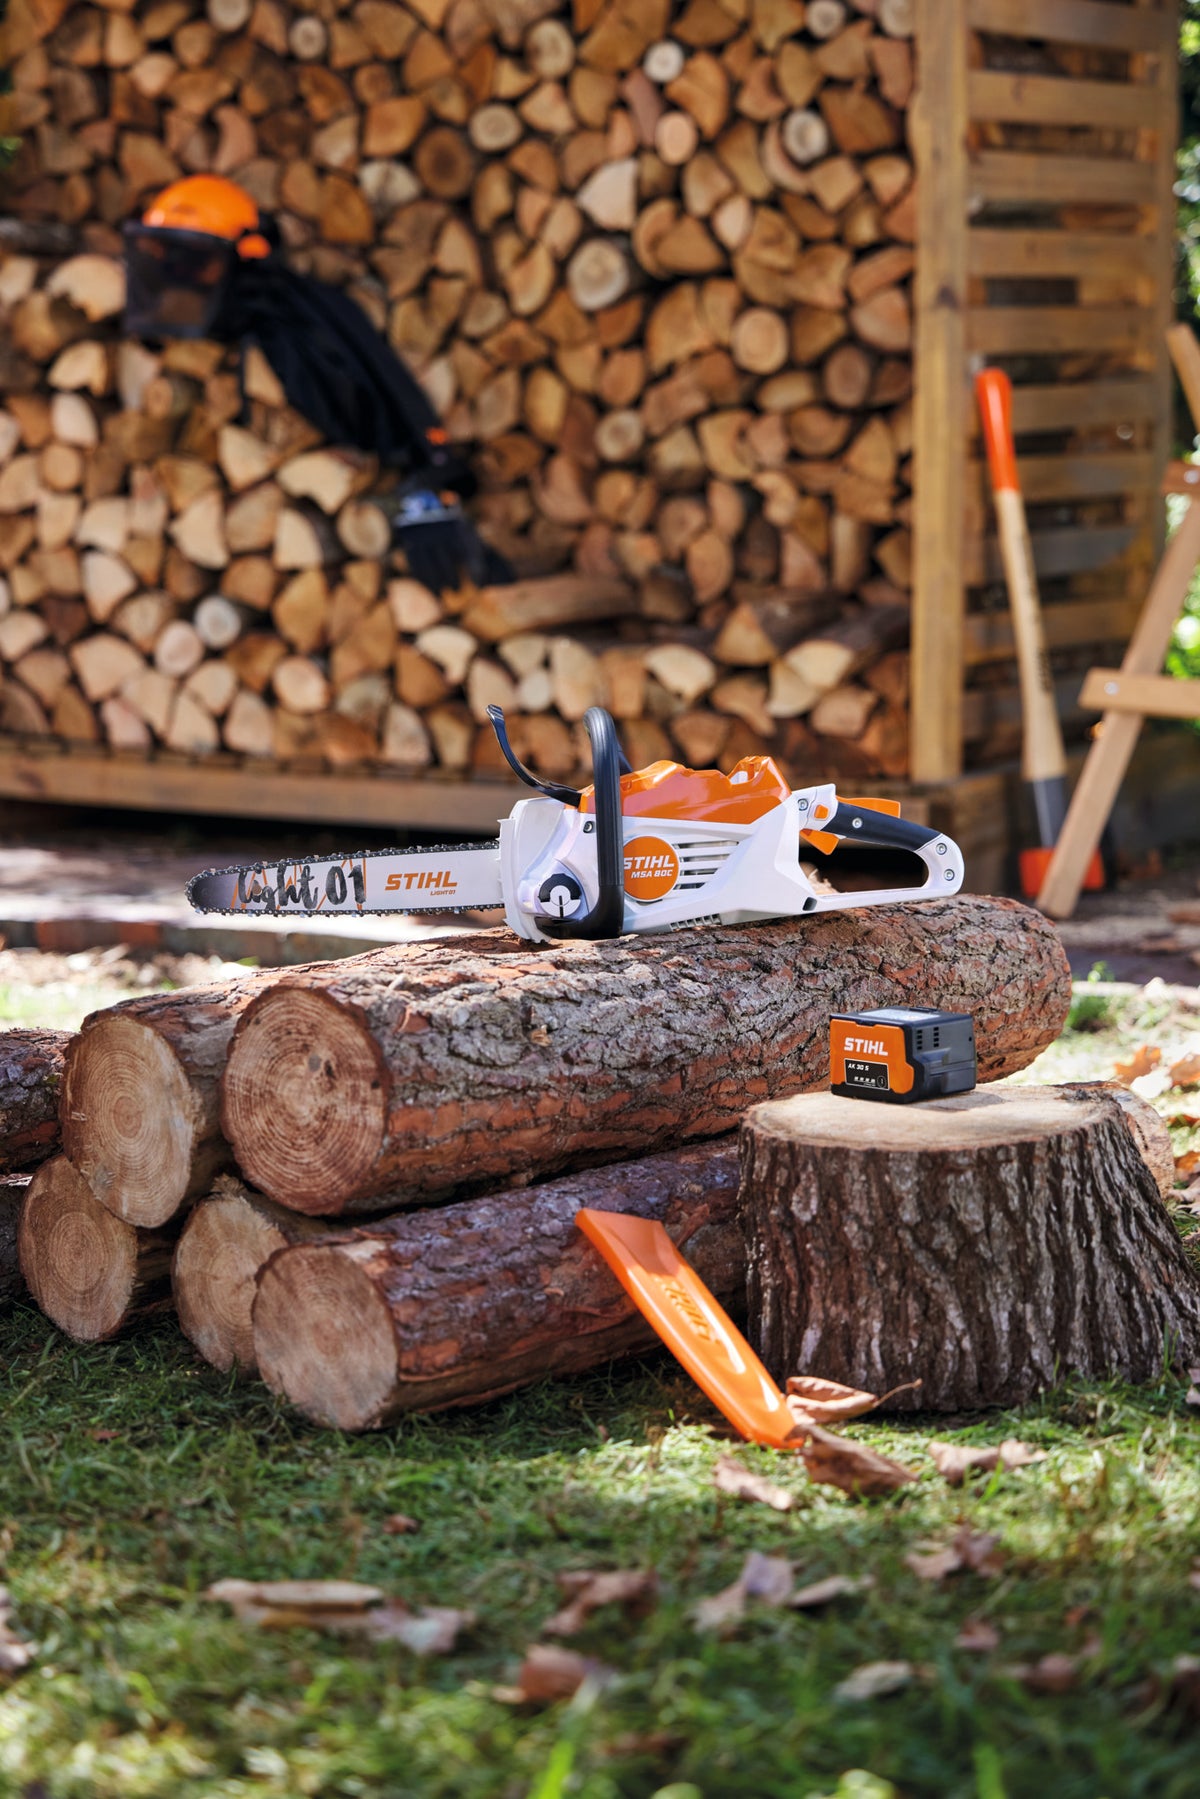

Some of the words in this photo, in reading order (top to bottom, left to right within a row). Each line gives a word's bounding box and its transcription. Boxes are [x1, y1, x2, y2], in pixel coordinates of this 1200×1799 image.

[623, 855, 675, 870] STIHL
[385, 871, 458, 891] STIHL
[631, 871, 653, 879] MSA
[325, 864, 366, 906] 01
[844, 1037, 889, 1056] STIHL
